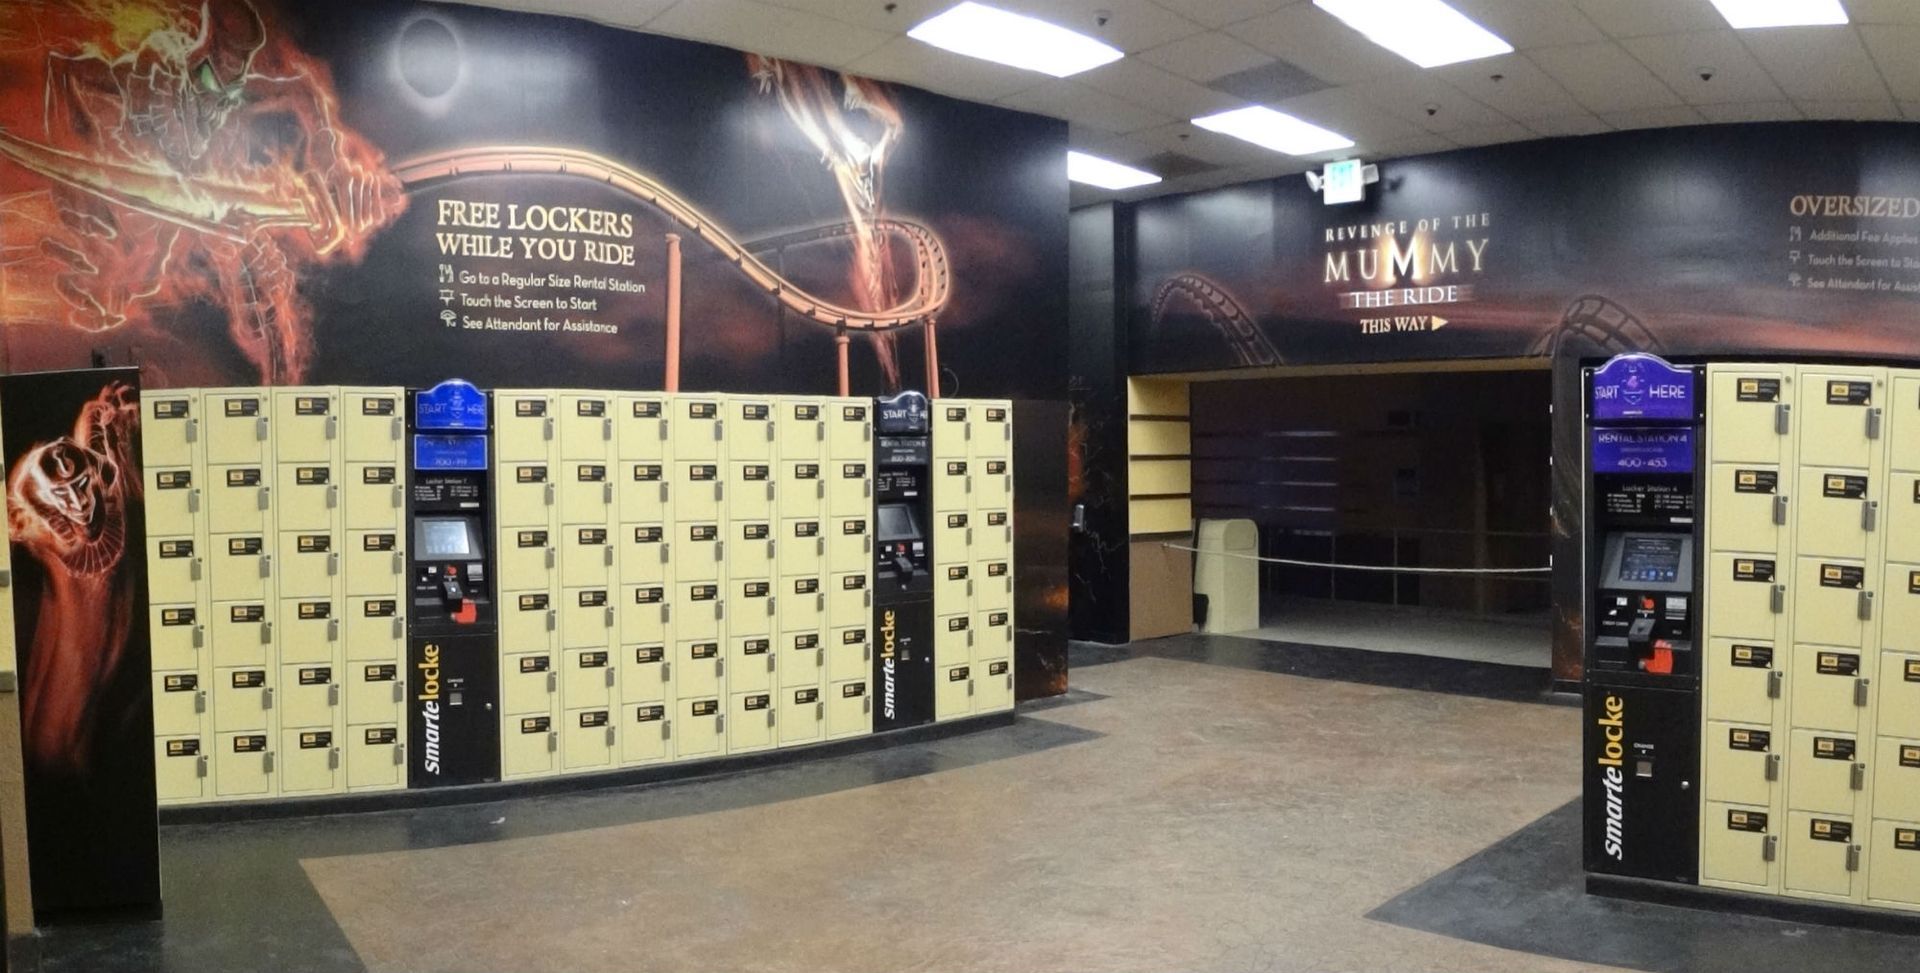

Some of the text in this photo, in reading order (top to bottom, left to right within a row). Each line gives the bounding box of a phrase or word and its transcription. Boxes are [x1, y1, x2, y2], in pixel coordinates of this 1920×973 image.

[1790, 195, 1920, 218] OVERSIZED
[437, 199, 633, 238] FREE LOCKERS
[1325, 212, 1490, 243] REVENGE OF THE
[1809, 229, 1859, 241] Additional
[436, 232, 635, 266] WHILE YOU RIDE
[1324, 237, 1489, 282] MUMMY
[1808, 254, 1836, 266] Touch
[1837, 253, 1854, 266] the
[1855, 255, 1888, 268] Screen
[1890, 257, 1901, 268] to
[459, 270, 646, 293] Go to a Regular Size Rental Station
[1807, 277, 1826, 289] See
[1827, 277, 1876, 291] Attendant
[1877, 278, 1892, 290] for
[461, 292, 598, 312] Touch the Screen to Start
[1351, 285, 1458, 309] THE RIDE
[462, 315, 619, 335] See Attendant for Assistance
[1360, 315, 1428, 334] THIS WAY
[1594, 384, 1686, 399] START HERE
[418, 403, 447, 415] START
[883, 409, 907, 420] START
[1598, 433, 1688, 443] RENTAL STATION 4
